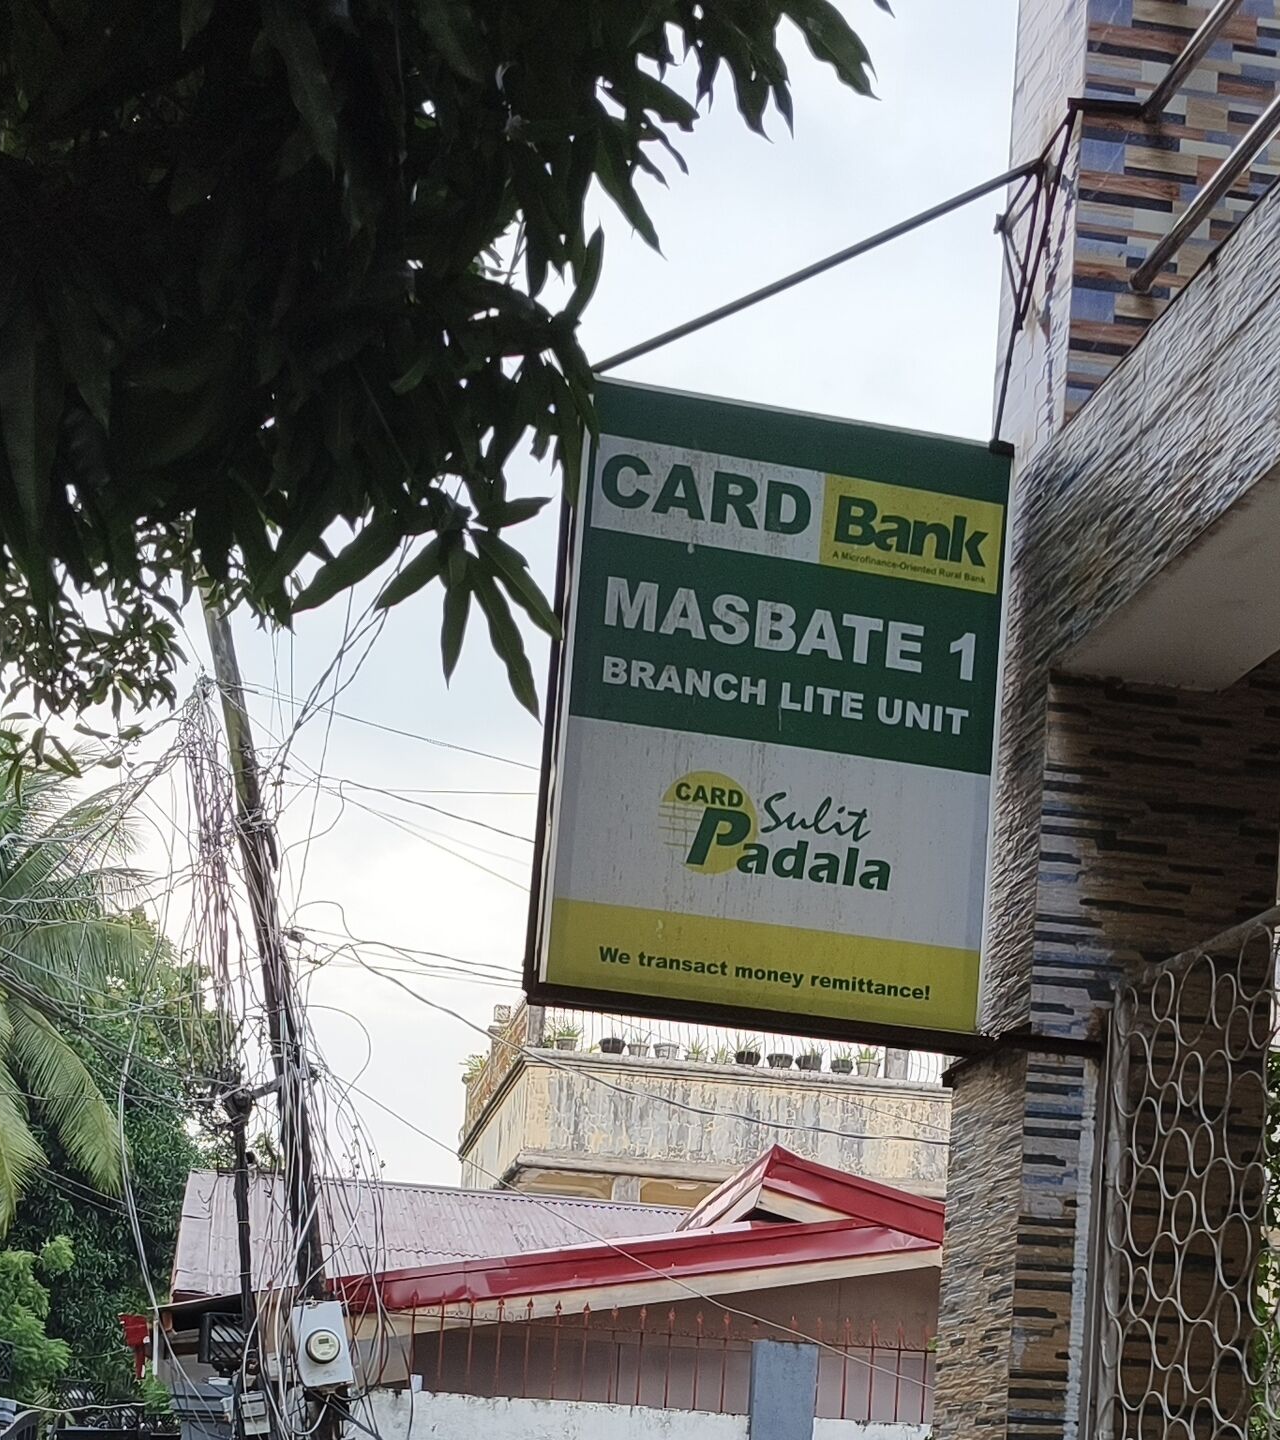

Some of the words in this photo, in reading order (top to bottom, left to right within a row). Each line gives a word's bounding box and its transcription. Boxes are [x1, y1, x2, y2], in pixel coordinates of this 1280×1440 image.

[601, 454, 811, 535] CARD
[833, 495, 988, 568] Bank
[832, 551, 839, 560] A
[841, 552, 937, 575] Microfinance-Oriented
[939, 568, 962, 580] Rural
[964, 573, 986, 584] Bank
[604, 578, 926, 673] MASBATE
[950, 633, 977, 681] 1
[603, 656, 767, 705] BRANCH
[781, 683, 863, 720] LITE
[877, 699, 969, 735] UNIT
[675, 783, 743, 808] CARD
[761, 792, 871, 840] Sulit
[687, 807, 891, 891] Padala
[599, 946, 630, 966] We
[638, 950, 728, 978] transact
[735, 962, 804, 988] money
[810, 970, 930, 1001] remittance!
